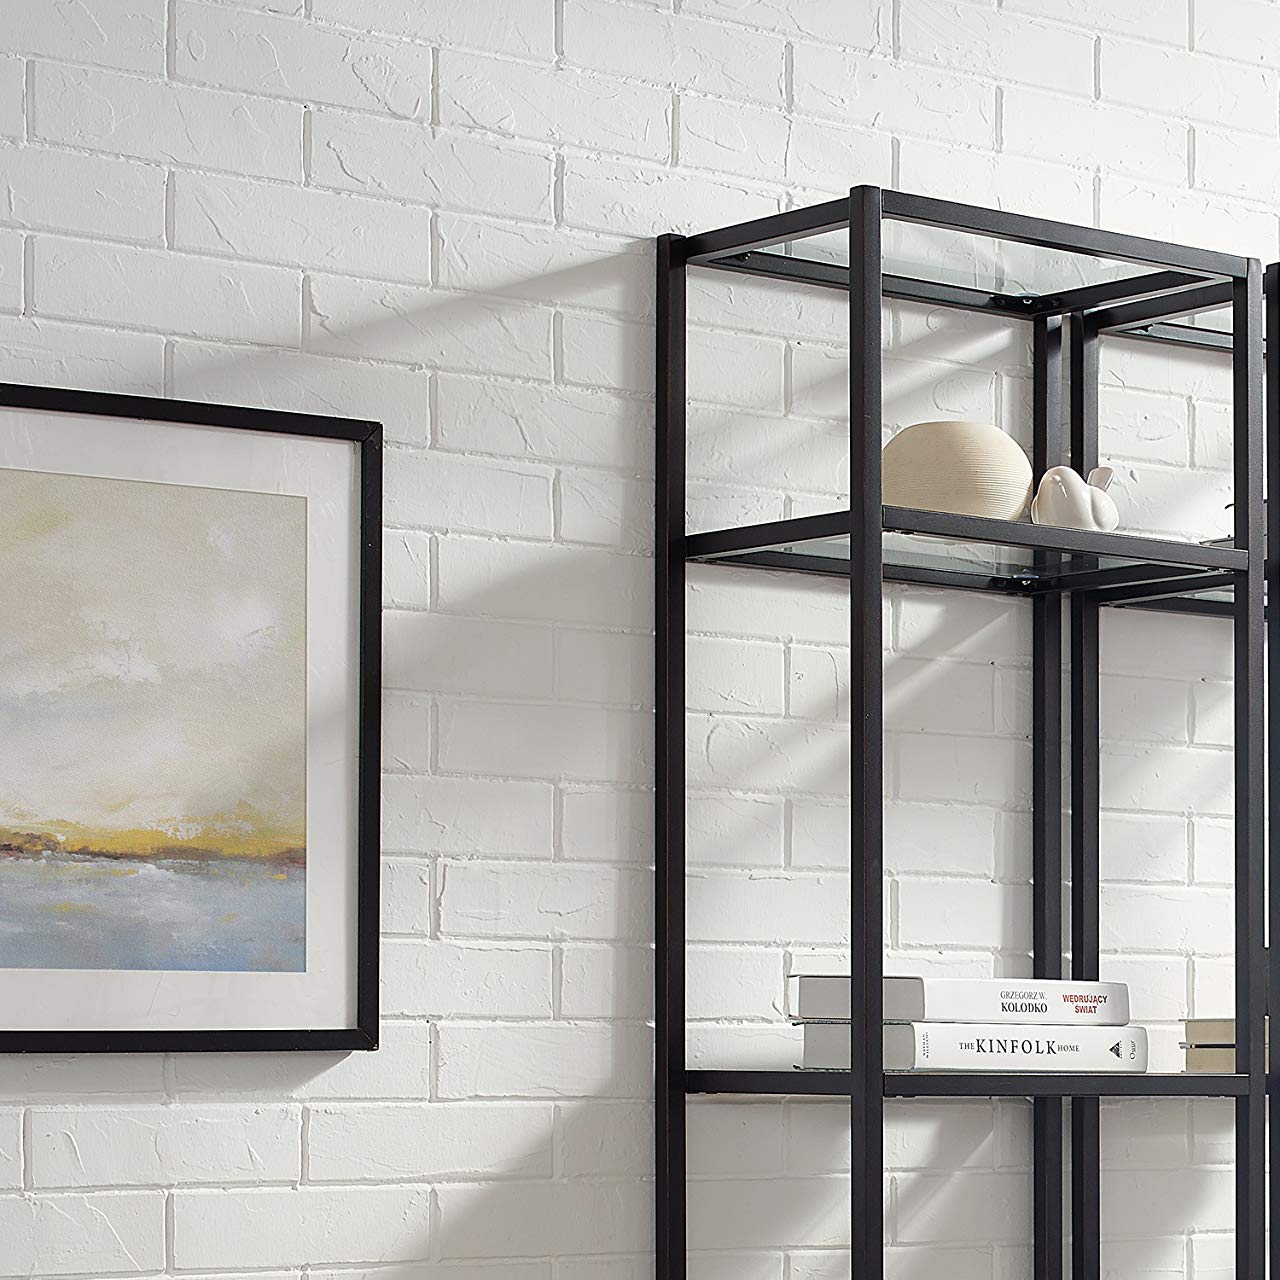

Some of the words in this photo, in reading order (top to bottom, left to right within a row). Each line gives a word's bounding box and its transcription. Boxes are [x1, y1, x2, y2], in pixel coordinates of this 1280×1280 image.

[1000, 990, 1038, 1000] GRZEGORZ
[959, 1042, 975, 1050] THE
[975, 1038, 1057, 1055] KINFOLK
[1057, 1044, 1080, 1052] HOME
